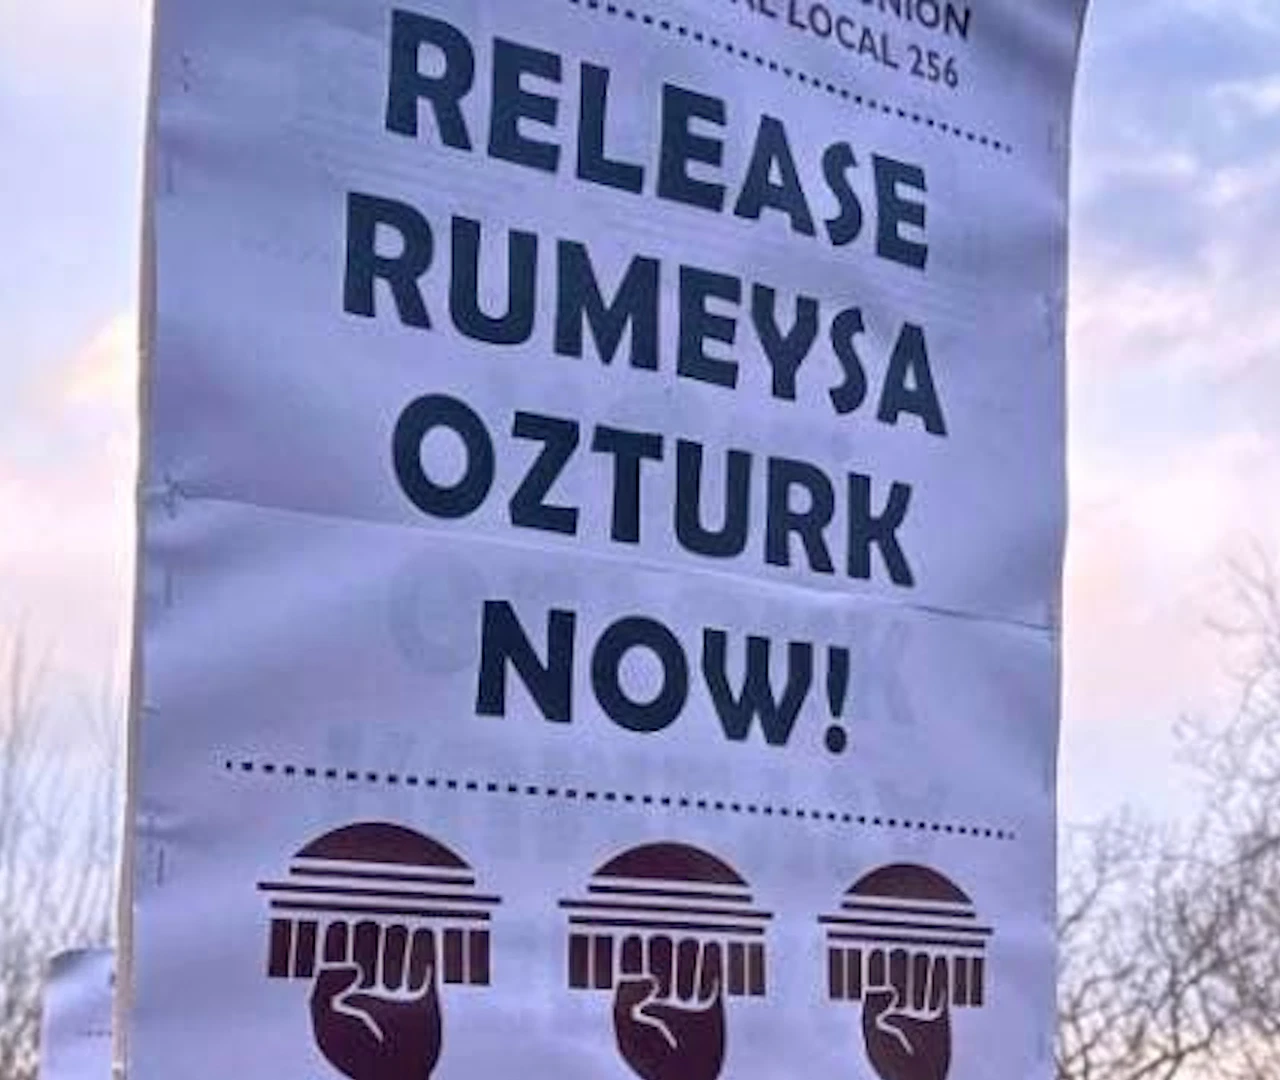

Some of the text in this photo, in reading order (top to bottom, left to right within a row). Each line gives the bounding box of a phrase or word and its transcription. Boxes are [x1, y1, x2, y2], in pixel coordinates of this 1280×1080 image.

[384, 9, 929, 271] RELEASE
[788, 8, 959, 88] LOCAL 256
[341, 191, 946, 436] RUMEYSA
[391, 392, 915, 588] OZTURK
[474, 600, 851, 754] NOW!
